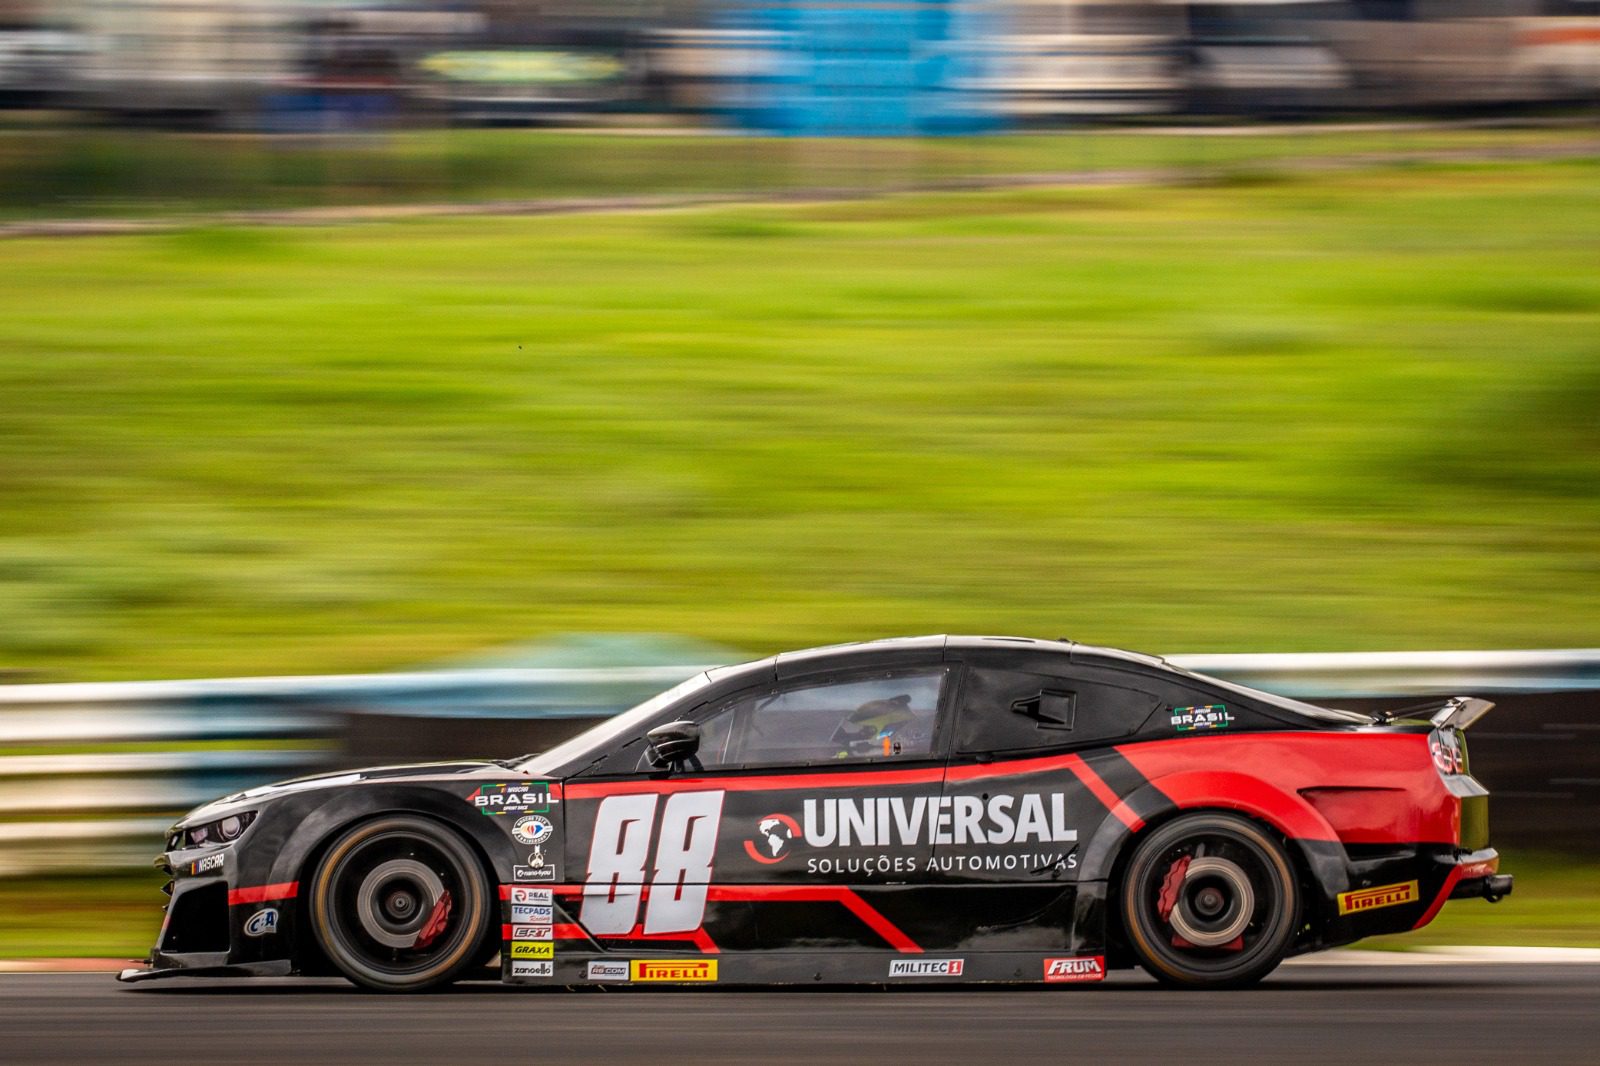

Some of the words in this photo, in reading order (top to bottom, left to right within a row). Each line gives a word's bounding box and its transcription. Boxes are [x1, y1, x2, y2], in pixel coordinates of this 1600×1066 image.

[1171, 712, 1235, 725] BRASIL
[475, 793, 559, 806] BRASIL
[804, 793, 1077, 847] UNIVERSAL
[198, 854, 224, 872] NASCAR
[579, 790, 725, 936] 88
[808, 855, 916, 877] SOLUÇÕES
[926, 853, 1077, 873] AUTOMOTIVAS
[1344, 885, 1410, 910] PIRELLI
[514, 907, 550, 915] TECPADS
[515, 928, 551, 937] ERT
[515, 946, 550, 954] GRAXA
[639, 963, 709, 978] PIRELLI
[1048, 958, 1101, 975] FRUM
